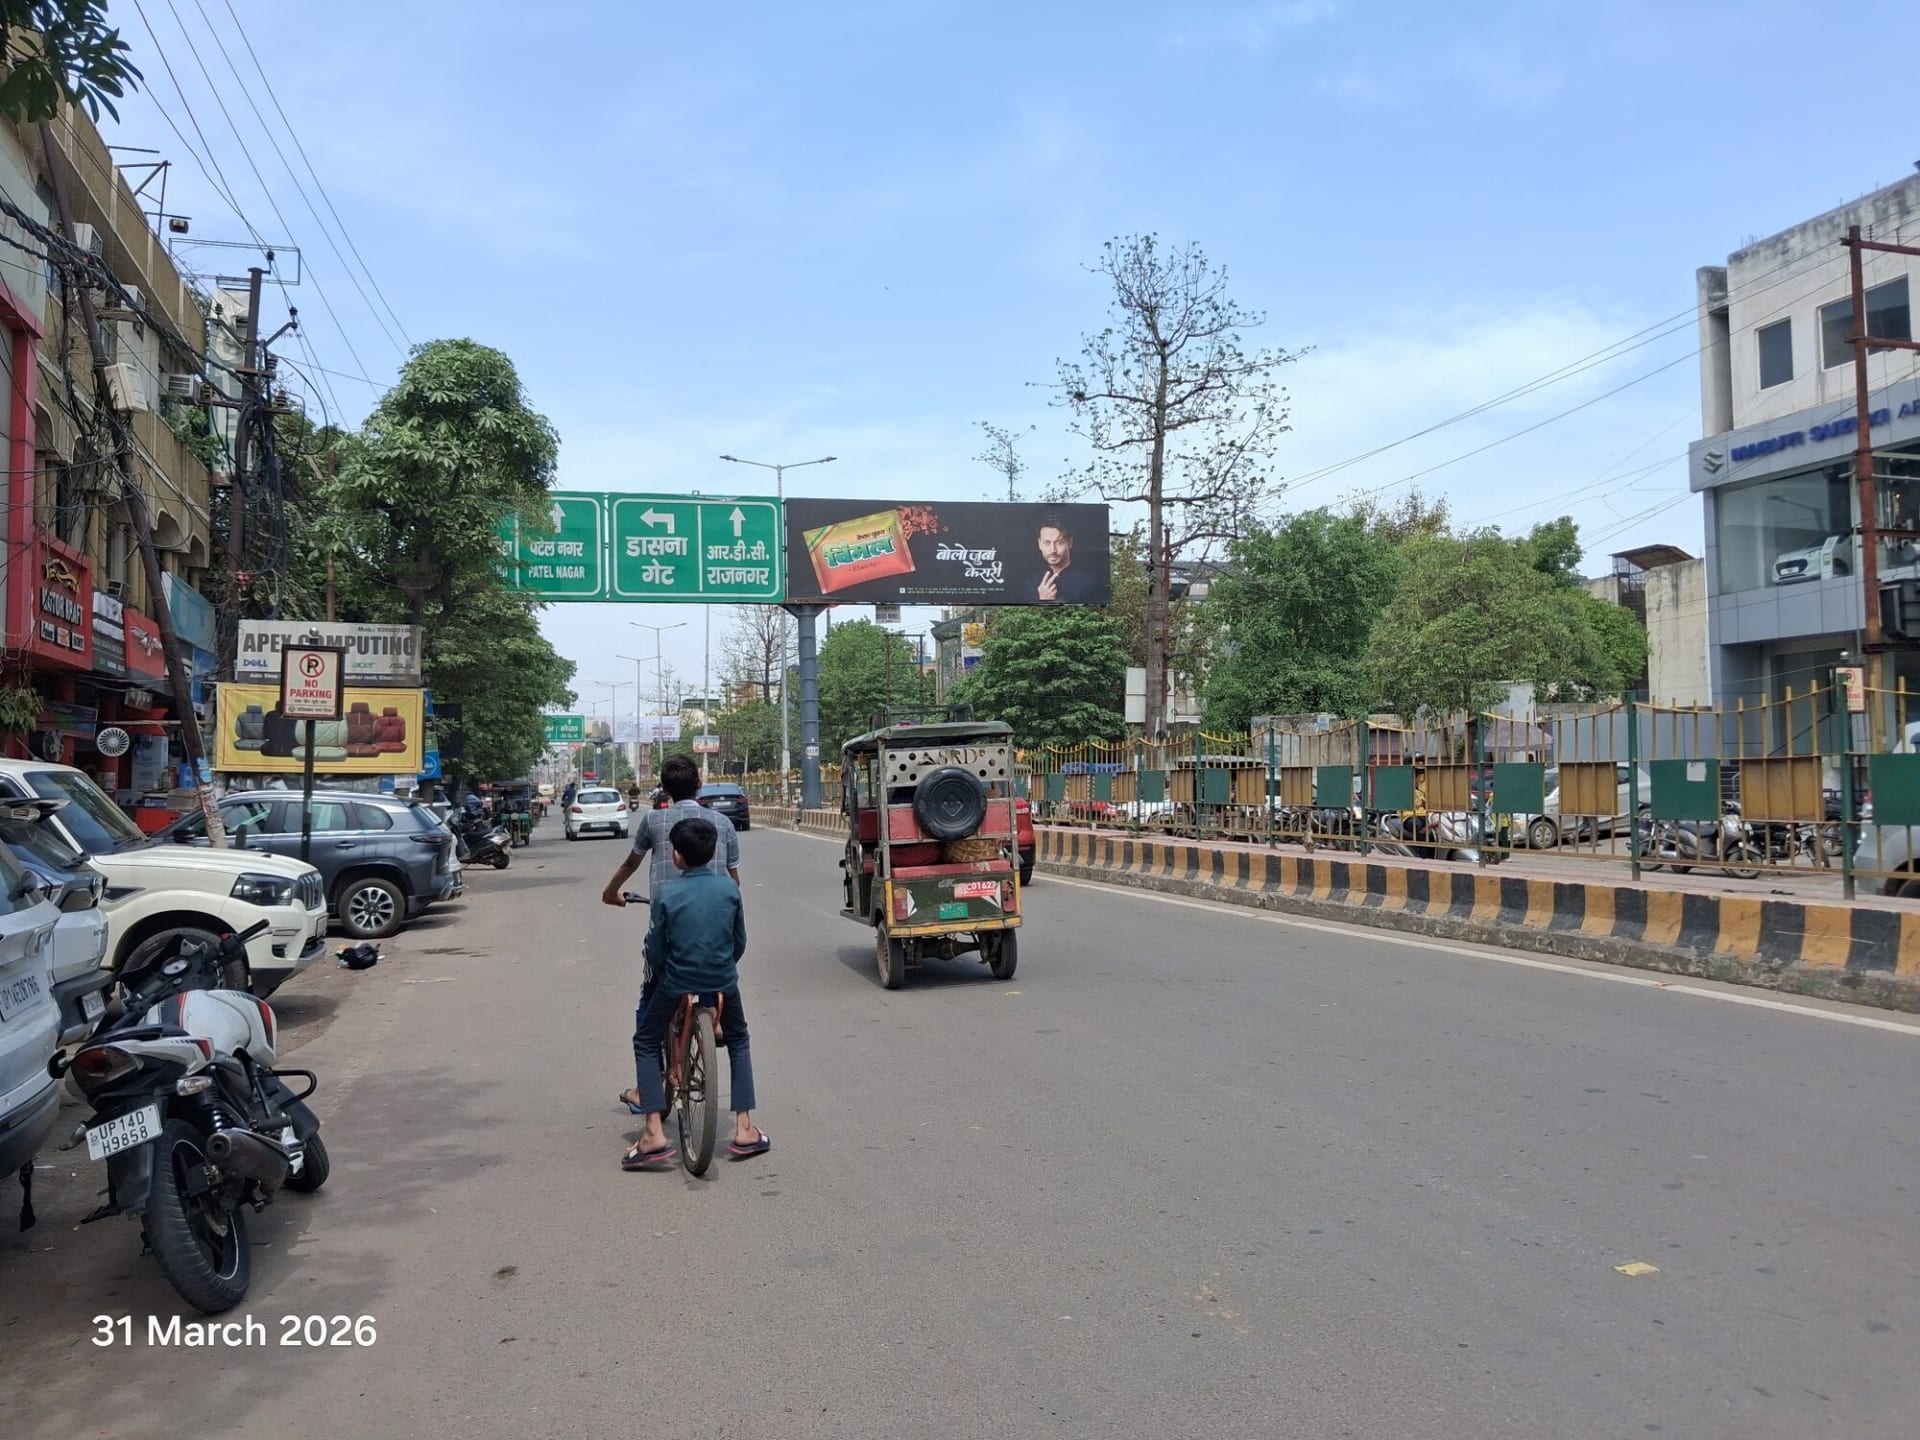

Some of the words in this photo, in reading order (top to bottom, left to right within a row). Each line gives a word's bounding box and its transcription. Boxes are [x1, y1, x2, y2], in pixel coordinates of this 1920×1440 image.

[529, 537, 555, 556] पटेल
[557, 541, 584, 556] नगर
[625, 536, 688, 557] डासना
[936, 543, 968, 560] बोलो
[528, 565, 554, 578] PATEL
[556, 566, 585, 578] NAGAR
[641, 558, 675, 585] गेट
[706, 567, 770, 585] राजनगर
[963, 561, 1004, 584] केसरी
[304, 680, 318, 688] NO
[290, 689, 332, 699] PARKING
[102, 1125, 148, 1155] H9858
